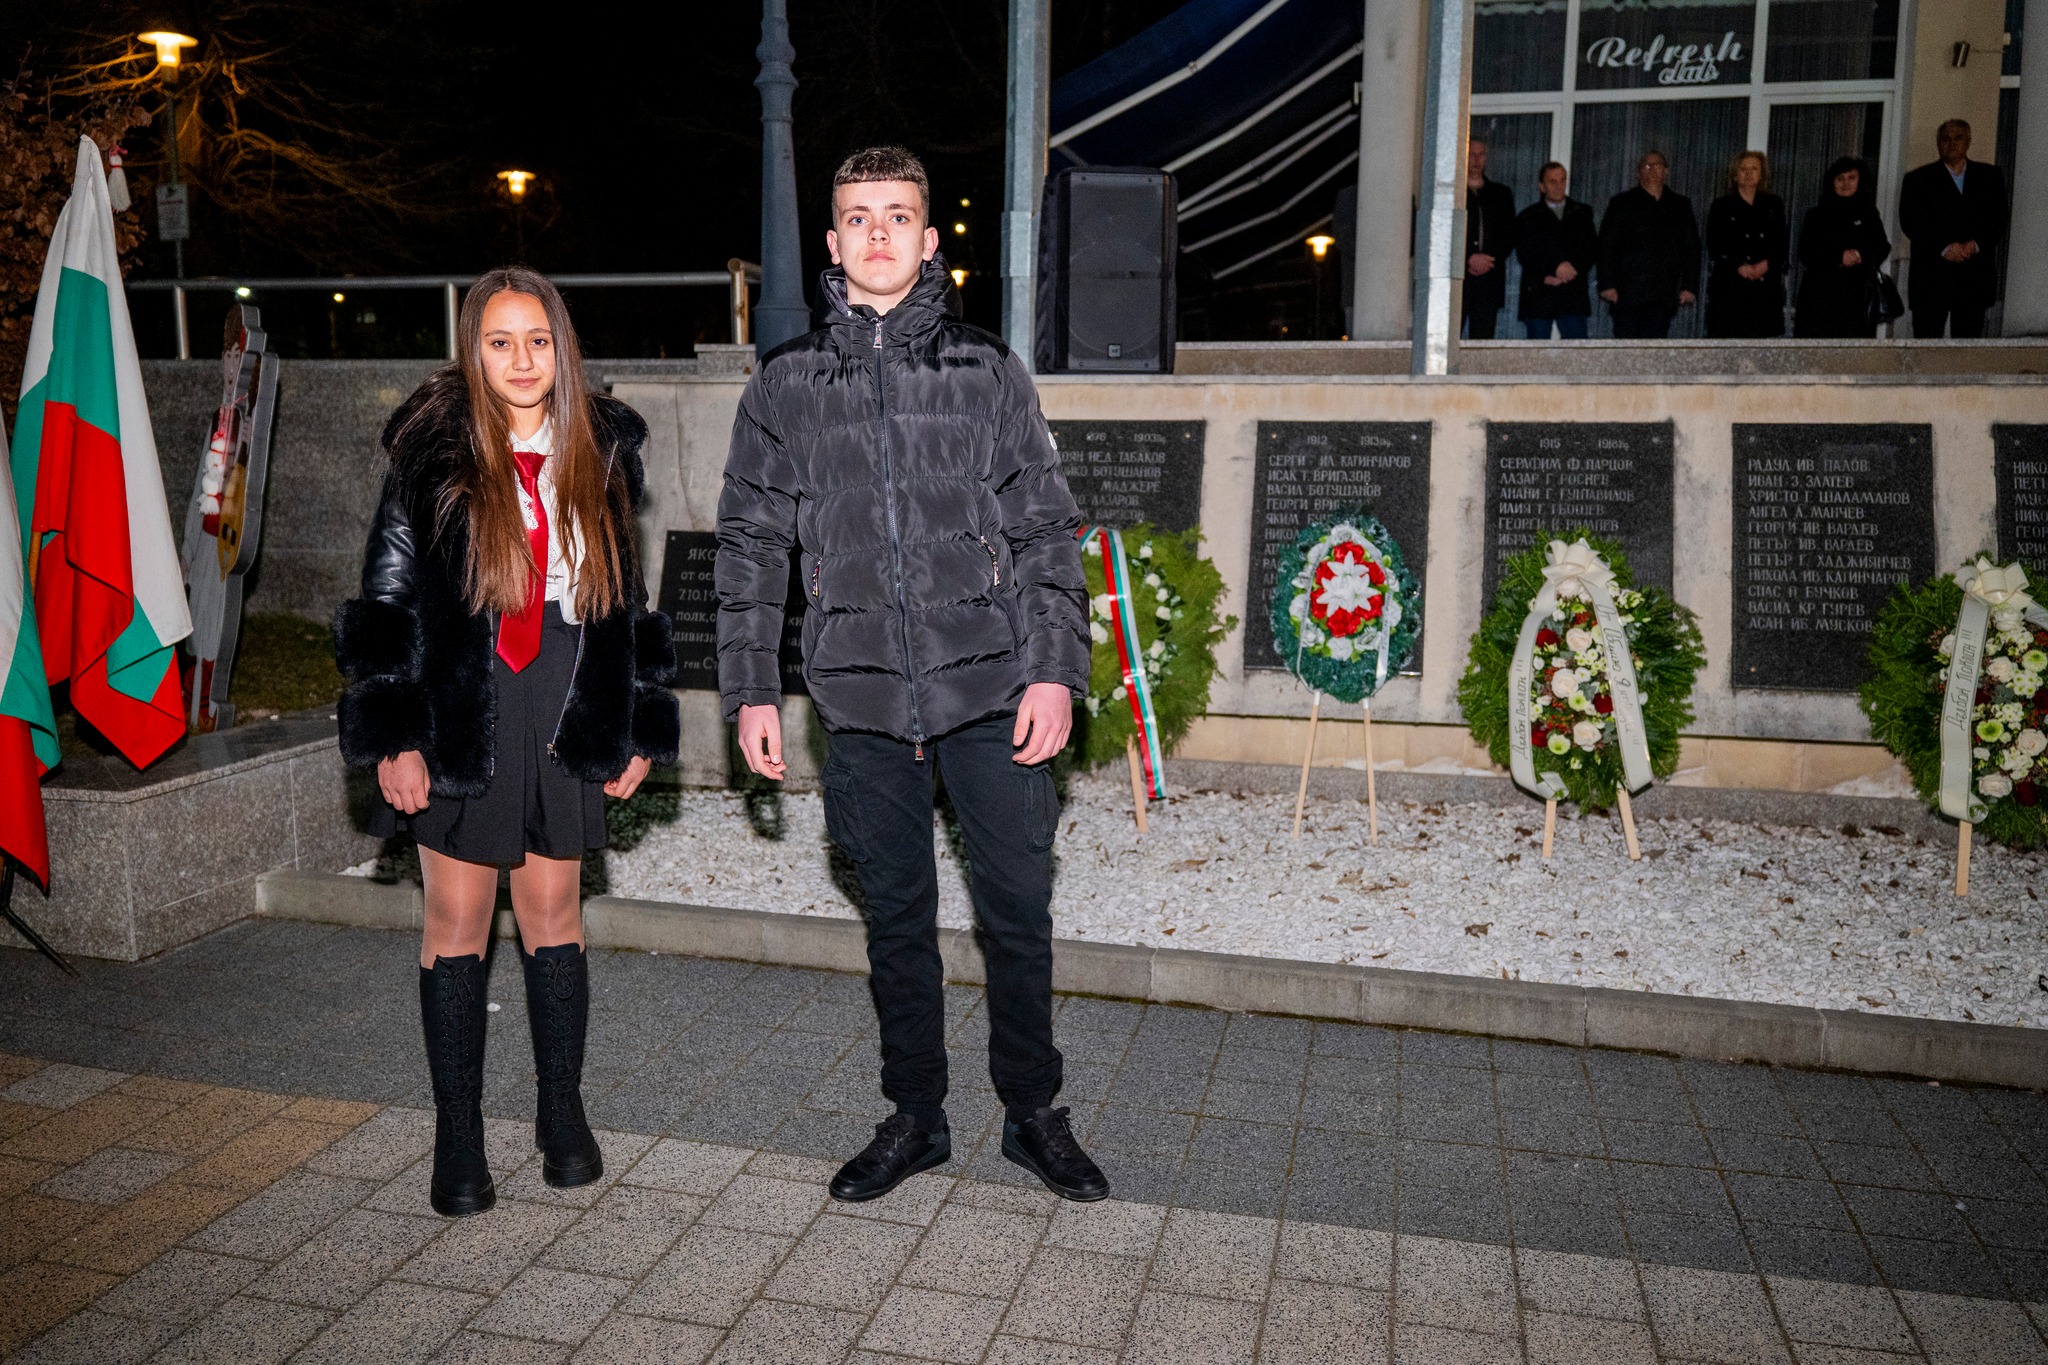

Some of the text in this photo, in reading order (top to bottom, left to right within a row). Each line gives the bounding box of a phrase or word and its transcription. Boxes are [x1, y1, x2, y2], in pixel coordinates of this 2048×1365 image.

[1586, 30, 1745, 72] Refresh
[1059, 452, 1084, 463] ОЯН
[2013, 461, 2048, 474] НИКО
[1268, 469, 1296, 482] ИСАК
[1749, 475, 1783, 488] ИВАН
[1267, 484, 1302, 496] ВАСИЛ
[2014, 477, 2047, 491] ПЕТ
[1749, 490, 1798, 503] ХРИСТО
[1819, 492, 1910, 505] ШАЛАМАНОВ
[2015, 493, 2048, 506] МУС
[1266, 499, 1308, 511] ГЕОРГИ
[1811, 506, 1865, 520] МАНЧЕВ
[1265, 528, 1300, 541] НИКОЛ
[1499, 533, 1538, 546] ИБРАХ
[687, 548, 716, 561] ЯКО
[680, 571, 694, 582] от
[673, 631, 717, 644] дивизи
